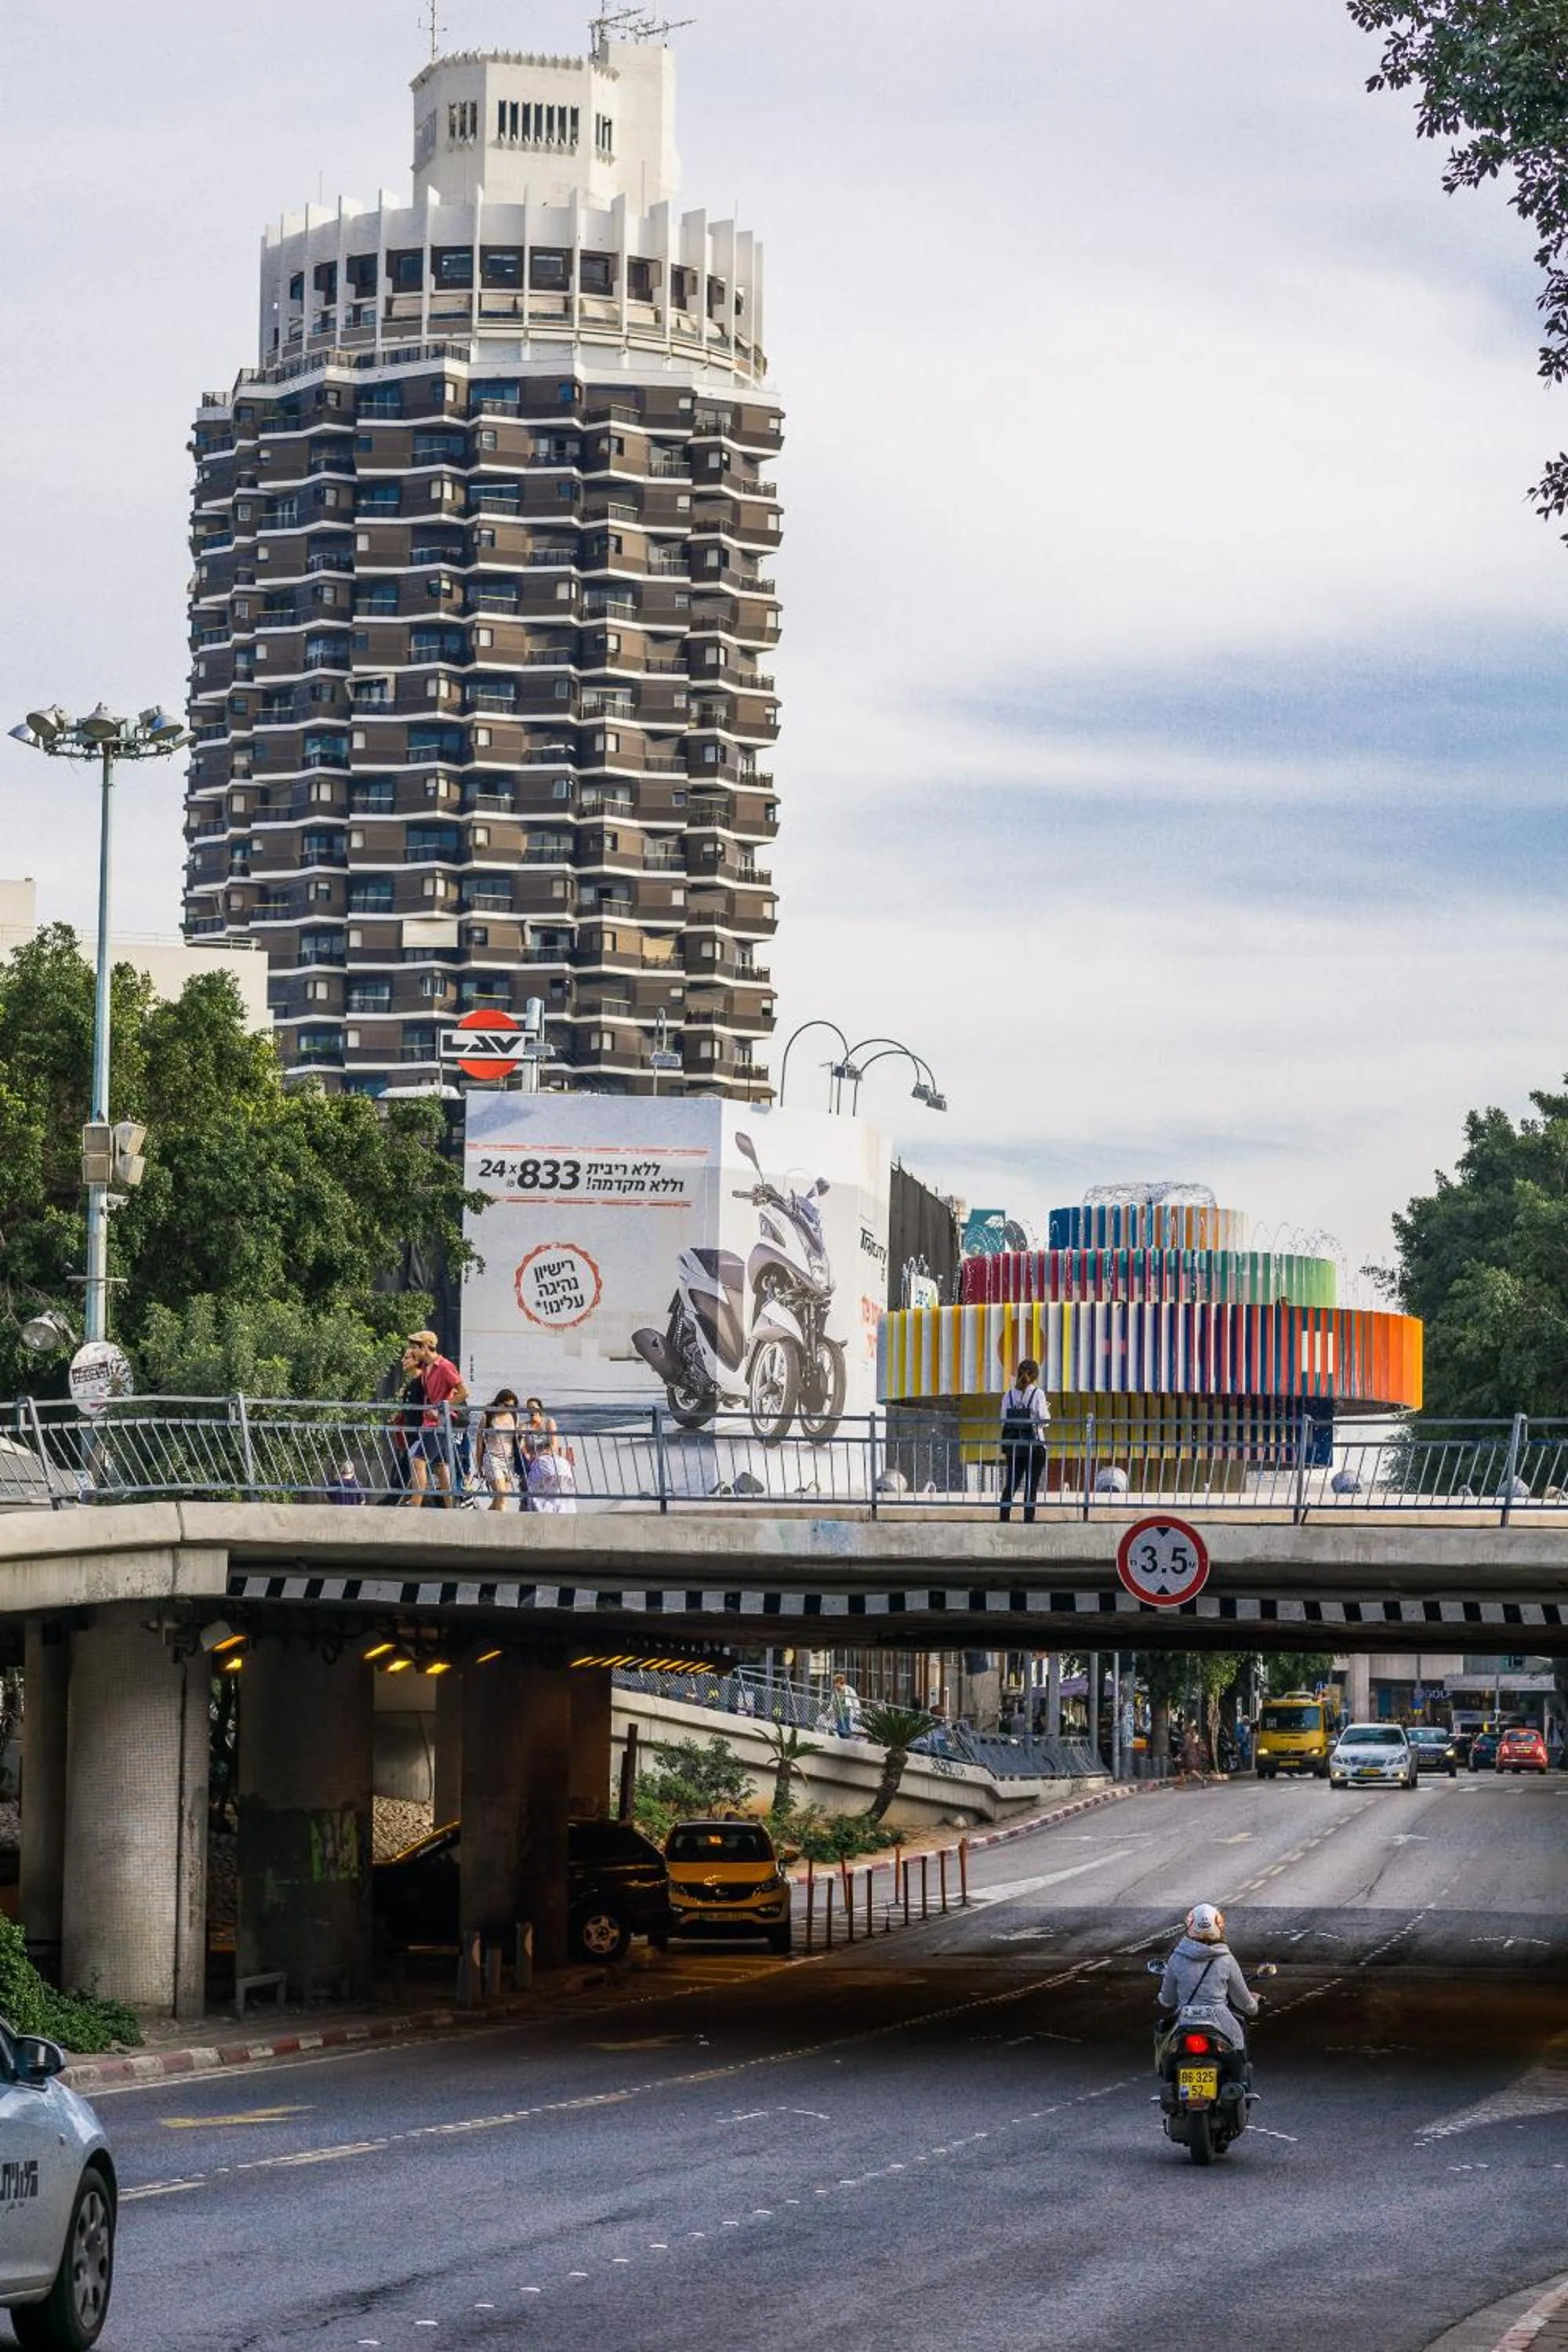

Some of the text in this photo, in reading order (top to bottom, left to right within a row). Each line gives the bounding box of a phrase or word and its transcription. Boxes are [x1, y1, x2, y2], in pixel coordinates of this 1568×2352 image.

[478, 1159, 506, 1178] 24
[517, 1159, 581, 1190] 833
[586, 1162, 661, 1176] ללא ריבית
[586, 1178, 684, 1193] וללא מקדמה!
[534, 1260, 575, 1283] רישיון
[538, 1277, 579, 1297] נהיגה
[1141, 1545, 1188, 1574] 3.5
